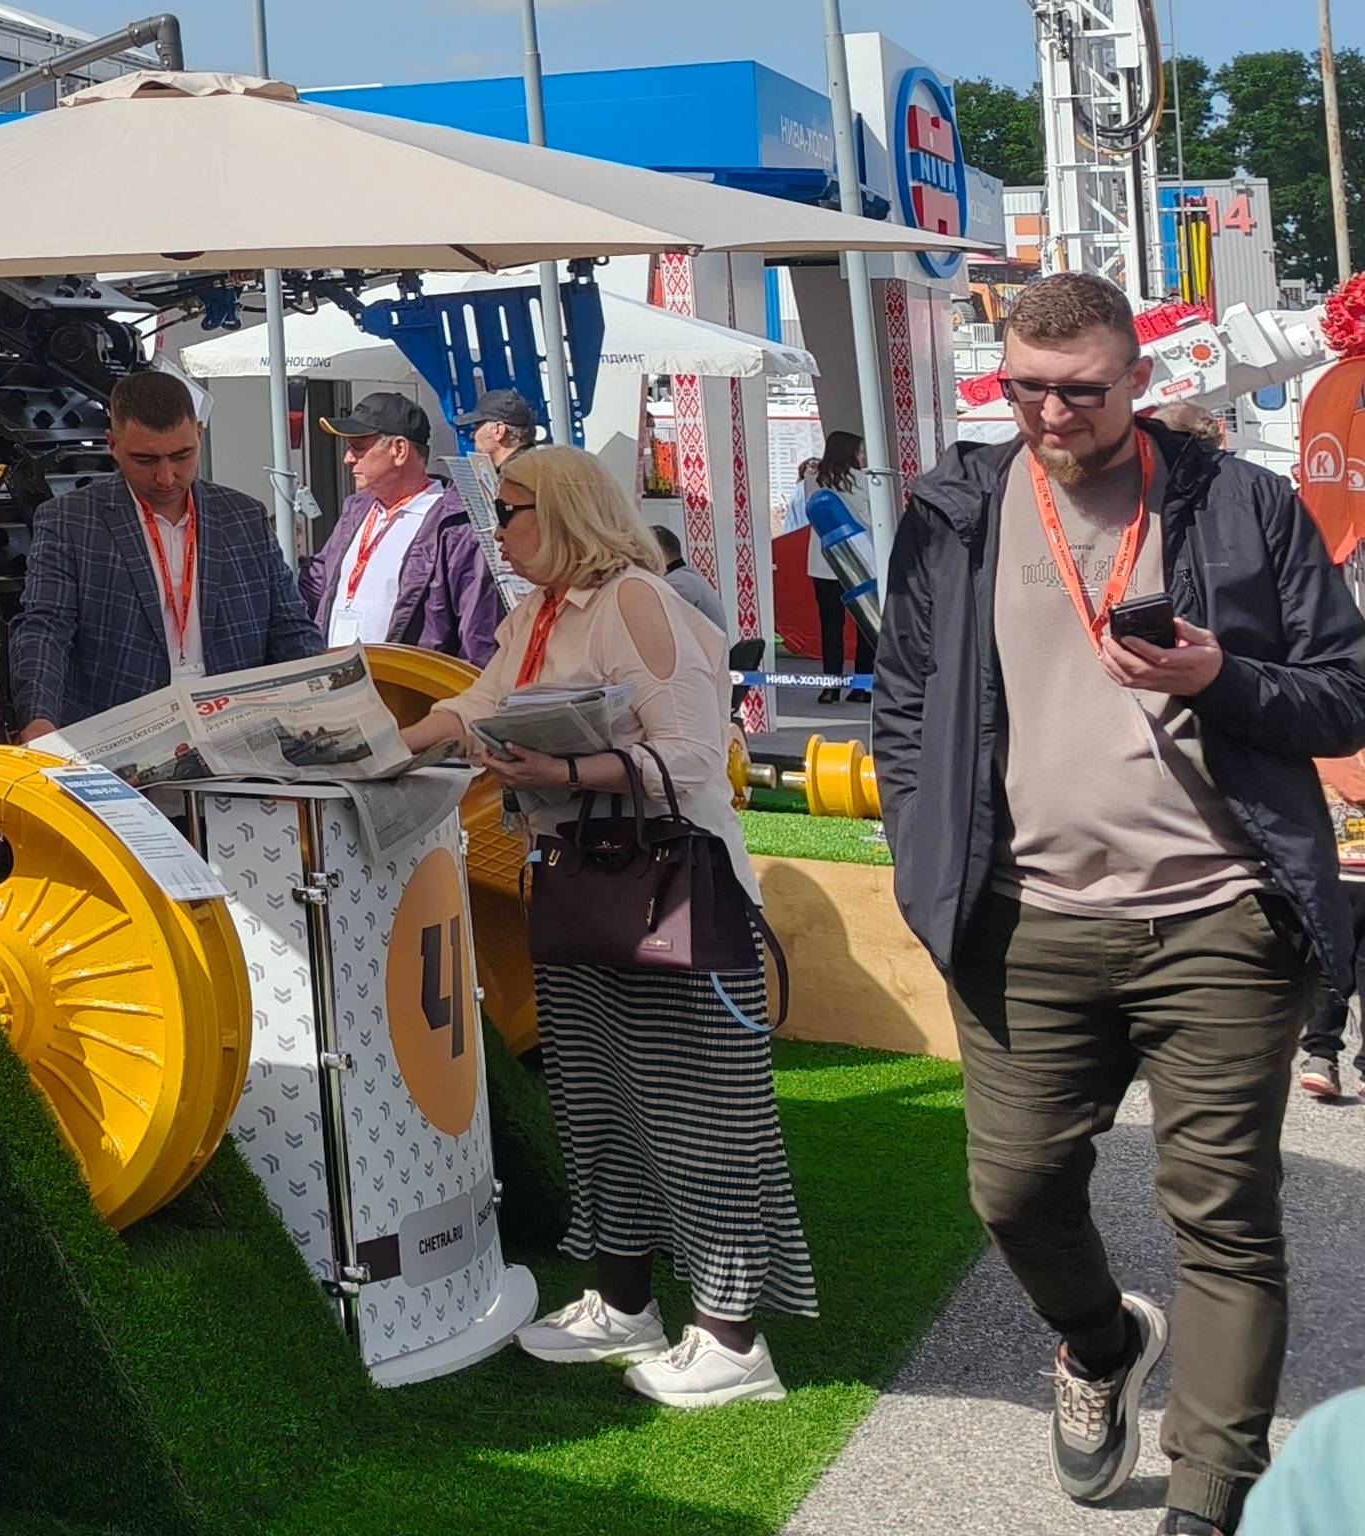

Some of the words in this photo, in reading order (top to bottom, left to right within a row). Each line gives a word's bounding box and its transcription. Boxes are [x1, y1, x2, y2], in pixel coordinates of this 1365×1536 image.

[919, 150, 958, 193] NIVA
[765, 673, 853, 688] НИВА-ХОЛДИНГ
[195, 695, 230, 716] ЭР
[148, 716, 176, 734] спроса
[418, 1223, 463, 1255] CHETRA.RU
